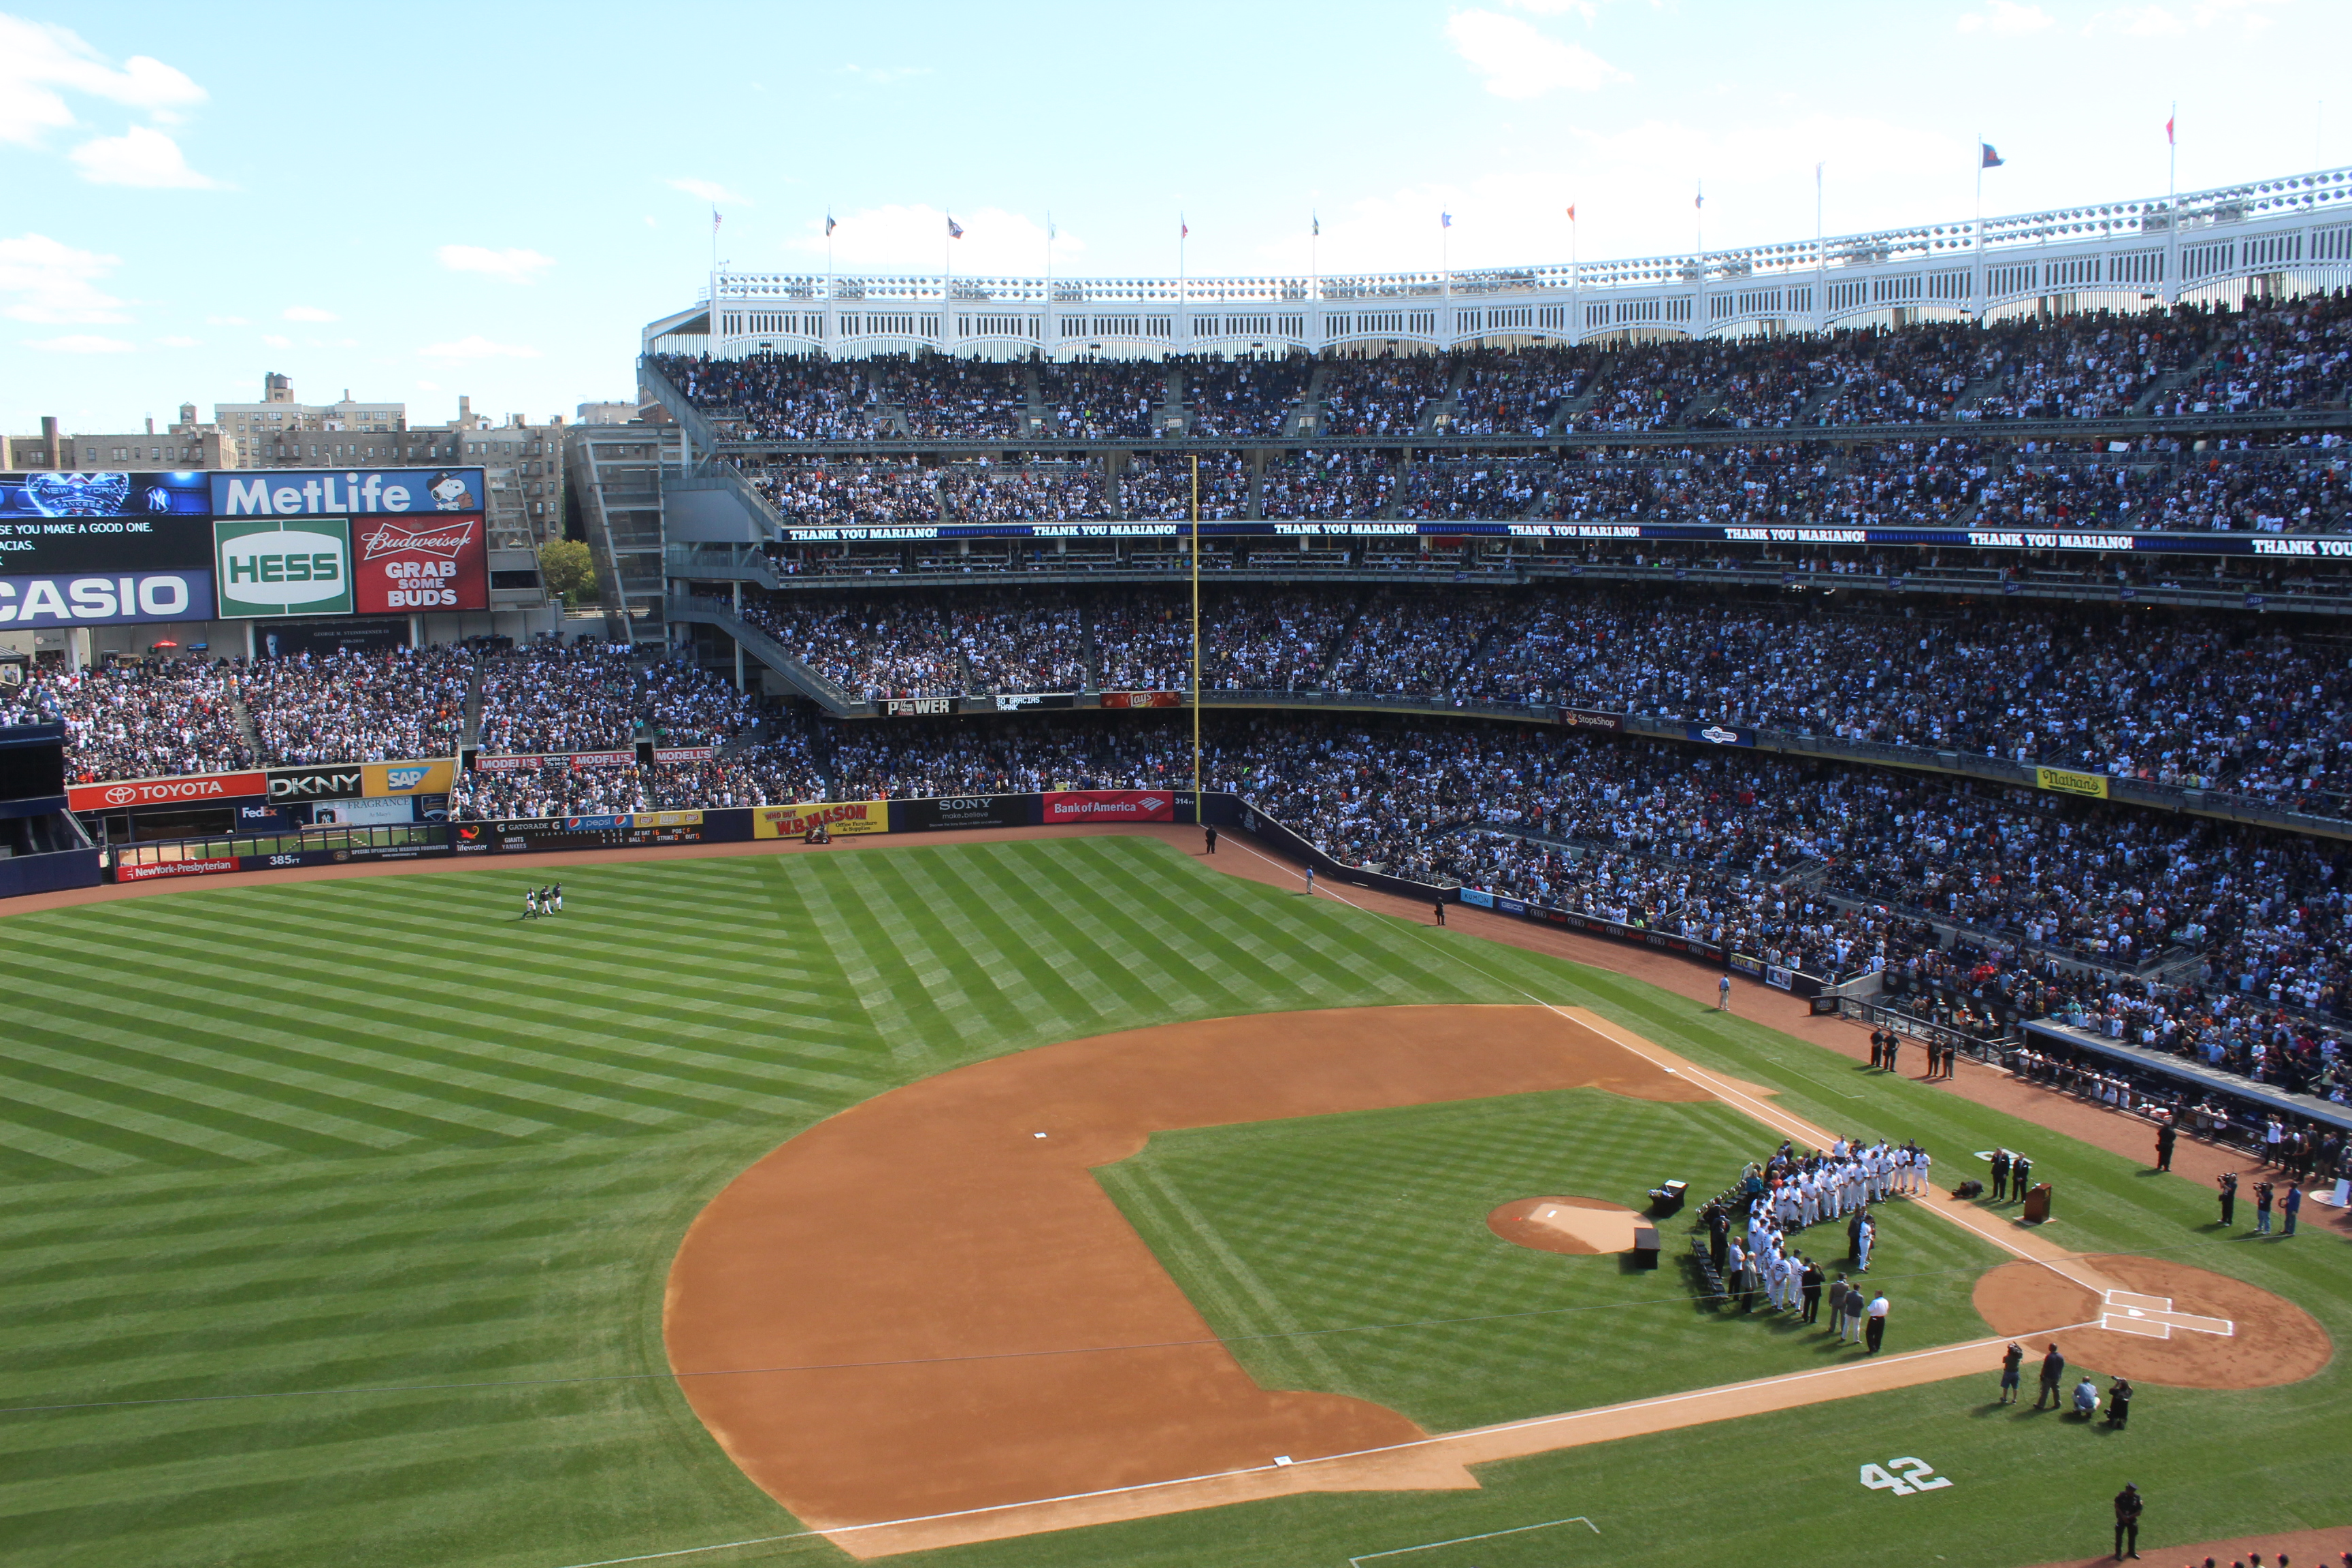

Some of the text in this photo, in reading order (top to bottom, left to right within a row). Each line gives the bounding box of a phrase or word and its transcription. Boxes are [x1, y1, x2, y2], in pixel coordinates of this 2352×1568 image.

[227, 472, 410, 515] MetLife
[15, 525, 40, 534] YOU
[44, 524, 76, 534] MAKE
[78, 524, 86, 534] A
[89, 523, 123, 533] GOOD
[126, 522, 153, 532] ONE.
[789, 527, 938, 540] THANK YOU MARIANO!
[1032, 525, 1177, 536] THANK YOU MARIANO!
[1275, 523, 1417, 534] THANK YOU MARIANO!
[1507, 525, 1640, 537] THANK YOU MARIANO!
[1725, 528, 1865, 542] THANK YOU MARIANO!
[1968, 533, 2133, 549] THANK YOU MARIANO!
[0, 540, 35, 551] ACIAS.
[361, 532, 471, 551] Budweiser
[2252, 539, 2352, 556] THANK YOU
[229, 553, 339, 583] HESS
[385, 561, 457, 578] GRAB
[397, 578, 446, 589] SOME
[387, 589, 457, 607] BUDS
[1578, 714, 1614, 728] Stop&Shop
[576, 754, 632, 764] MODELL'S
[657, 750, 711, 760] MODELL'S
[269, 773, 361, 796] DKNY
[388, 770, 421, 787] SAP
[2042, 770, 2098, 790] Nathan's
[139, 781, 223, 800] TOYOTA
[348, 797, 410, 809] FRAGRANCE
[939, 798, 992, 811] SONY
[1055, 802, 1136, 814] Bank of America
[242, 806, 278, 818] FedEx
[766, 812, 781, 820] WHO
[586, 818, 610, 828] pepsi
[1465, 893, 1489, 904] KUMON
[1501, 901, 1523, 911] GEICO
[1550, 913, 1565, 922] Audi
[1587, 922, 1604, 932] Audi
[1627, 931, 1645, 941] Audi
[1668, 941, 1686, 950] Audi
[1707, 951, 1722, 961] Audi
[1776, 1264, 1784, 1272] 25
[1860, 1456, 1955, 1496] 42
